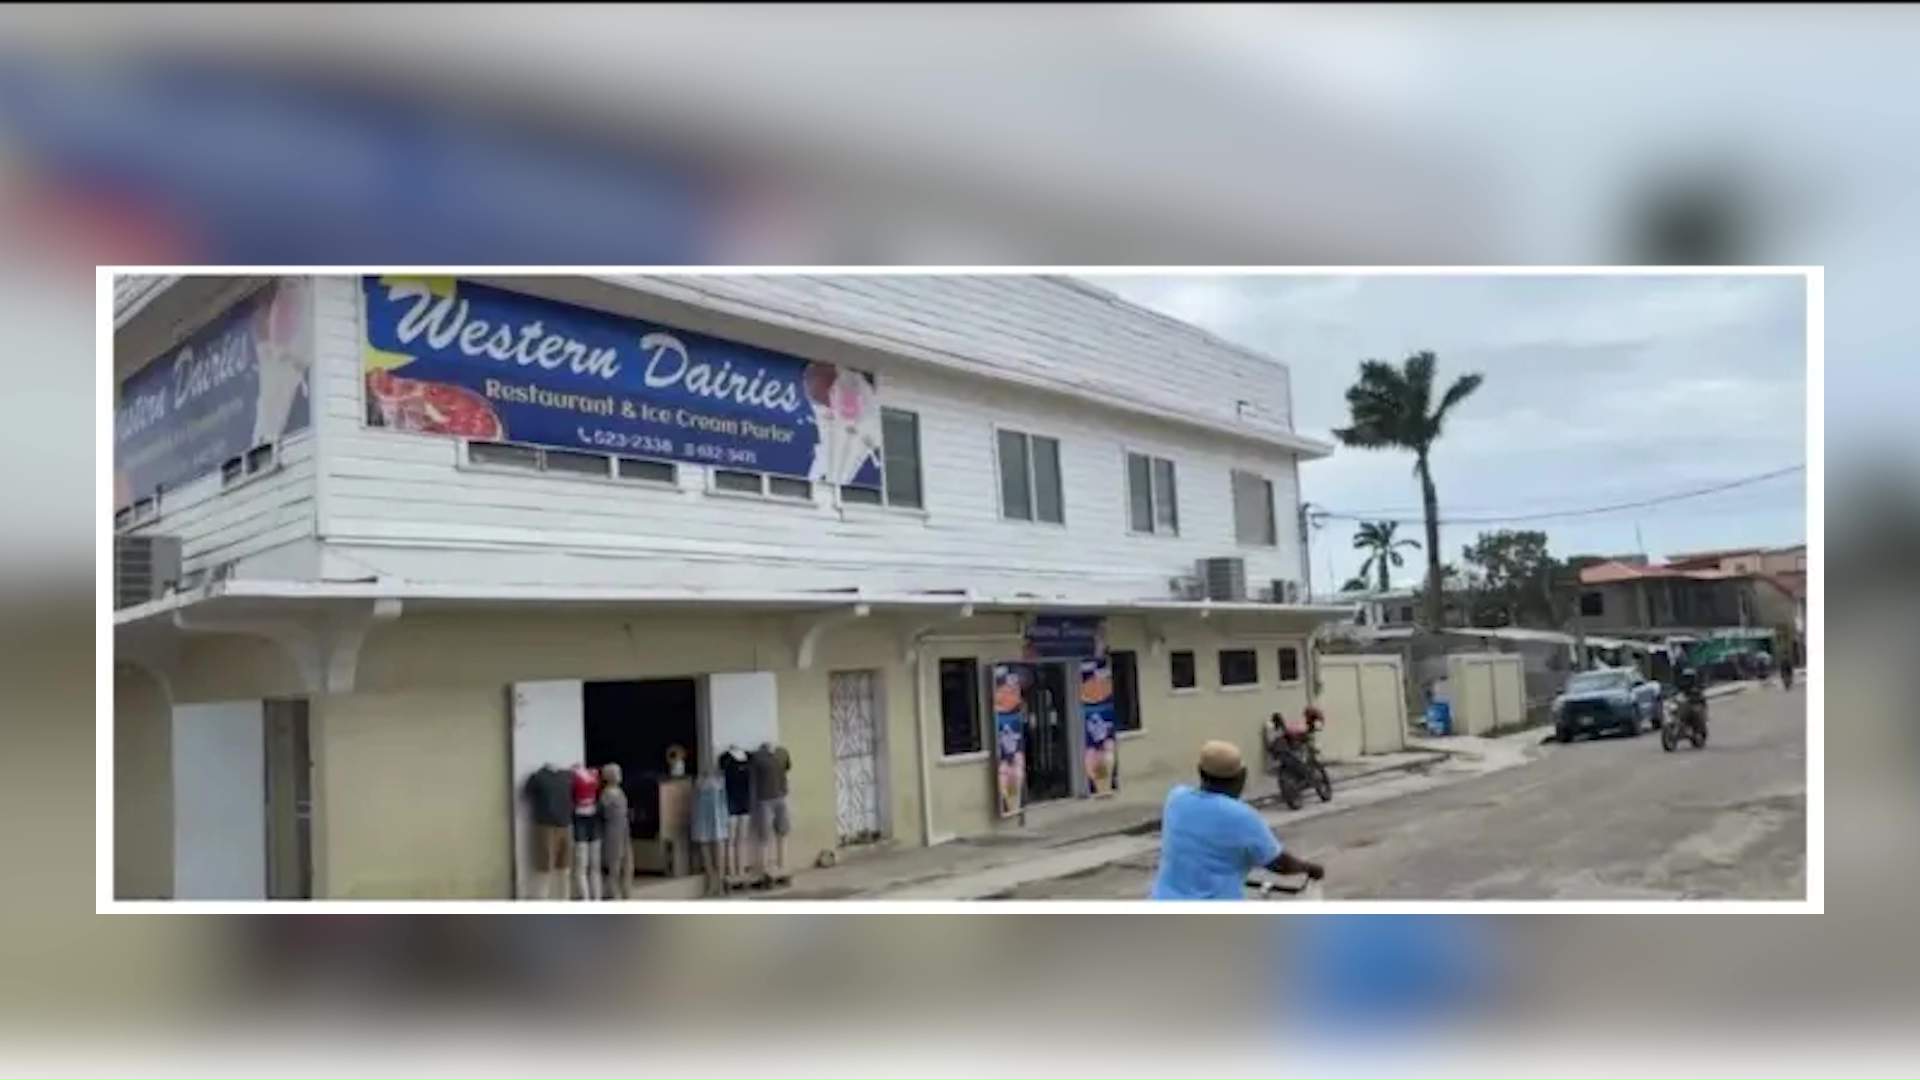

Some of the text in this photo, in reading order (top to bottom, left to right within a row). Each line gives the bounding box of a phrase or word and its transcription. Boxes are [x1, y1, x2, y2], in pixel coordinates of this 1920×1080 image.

[388, 281, 800, 412] Western Dairies
[485, 378, 794, 443] Restaurant & Ice Cream Parlor
